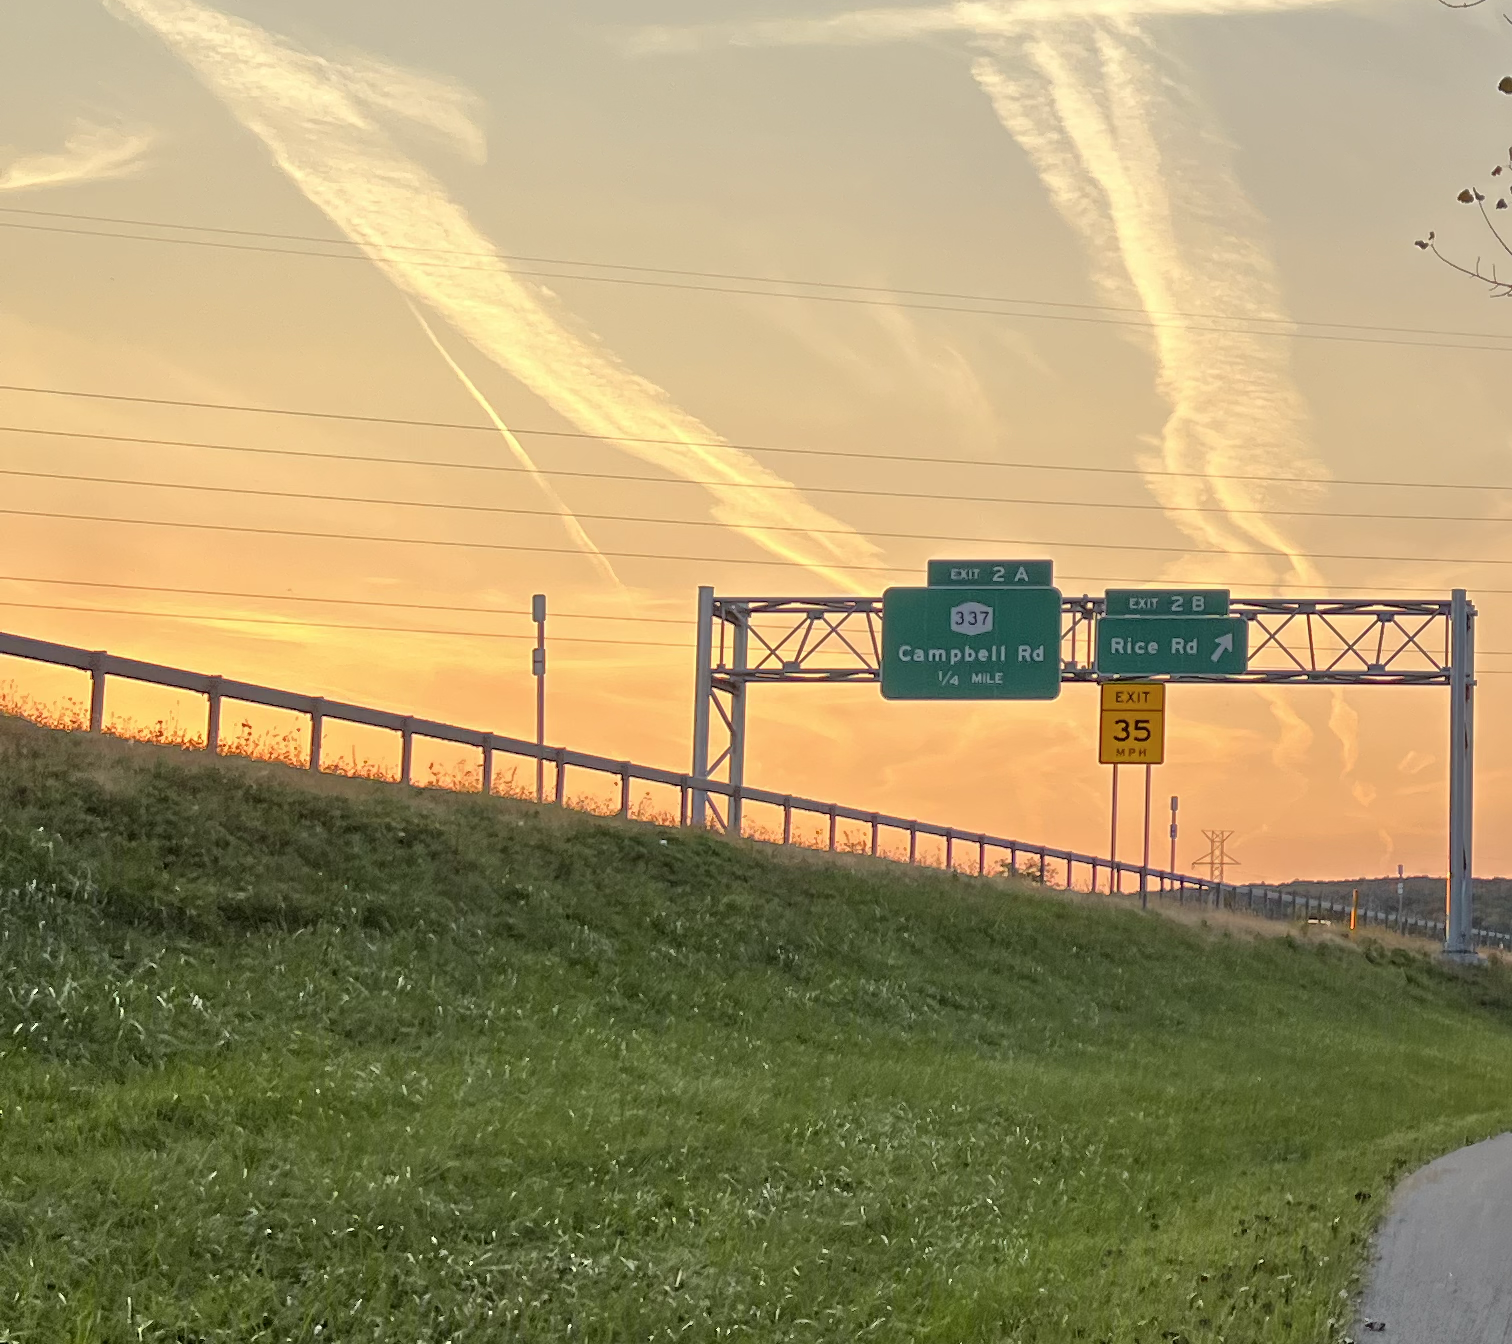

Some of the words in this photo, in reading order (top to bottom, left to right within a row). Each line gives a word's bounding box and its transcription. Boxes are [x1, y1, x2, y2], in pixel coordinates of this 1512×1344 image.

[950, 568, 981, 580] EXIT
[992, 566, 1005, 582] 2
[1014, 566, 1029, 582] A
[1128, 597, 1159, 610] EXIT
[1171, 596, 1184, 611] 2
[1191, 596, 1205, 611] B
[955, 611, 990, 626] 337
[1111, 637, 1159, 654] Rice
[1171, 637, 1198, 654] Rd
[898, 645, 1006, 665] Campbell
[1018, 645, 1044, 662] Rd
[971, 672, 1004, 684] MILE
[1115, 691, 1150, 703] EXIT
[1113, 719, 1151, 742] 35
[1115, 748, 1147, 757] MPH
